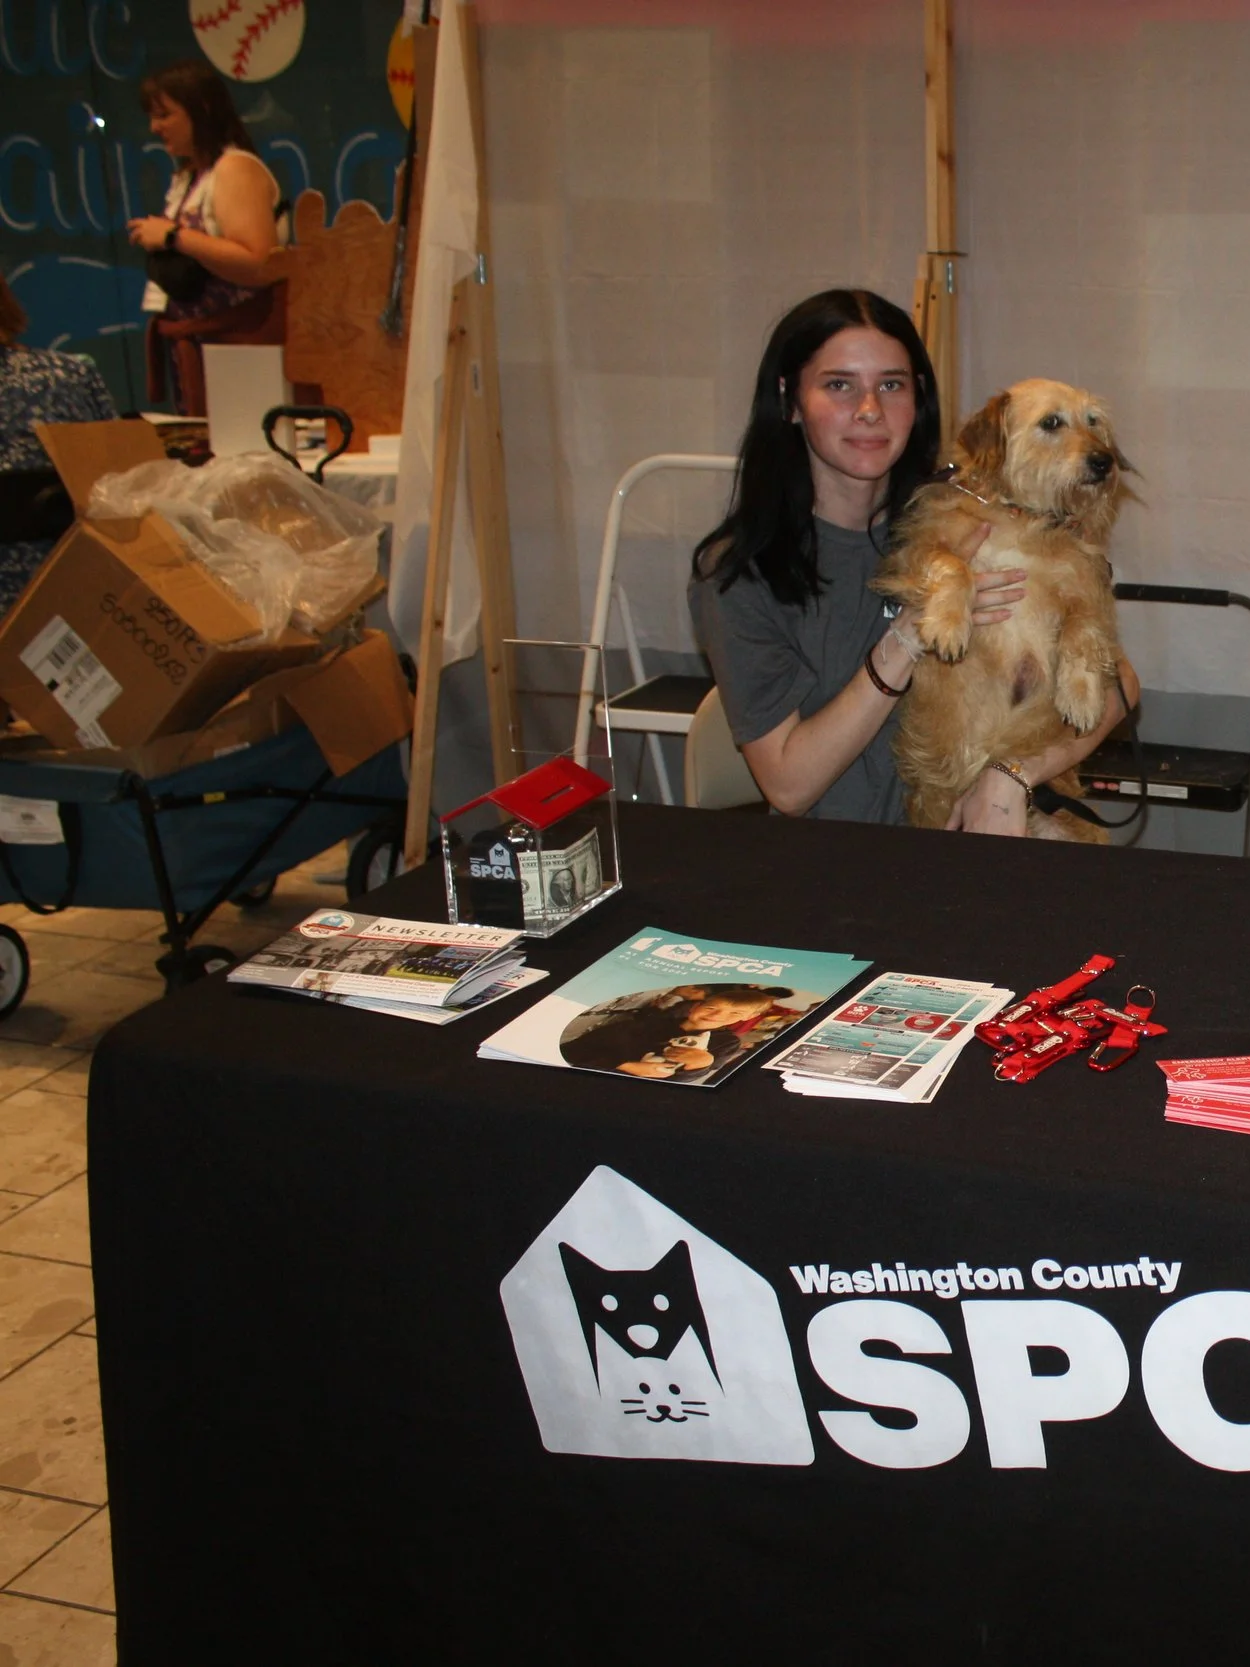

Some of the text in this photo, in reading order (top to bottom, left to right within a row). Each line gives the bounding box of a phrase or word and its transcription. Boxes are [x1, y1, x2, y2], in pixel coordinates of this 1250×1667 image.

[469, 864, 516, 881] SPCA
[372, 924, 503, 942] NEWSLETTER
[644, 957, 731, 976] ANNUAL REPORT
[693, 955, 783, 977] SPCA
[904, 977, 937, 986] SPCA
[790, 1257, 1182, 1299] Washington County
